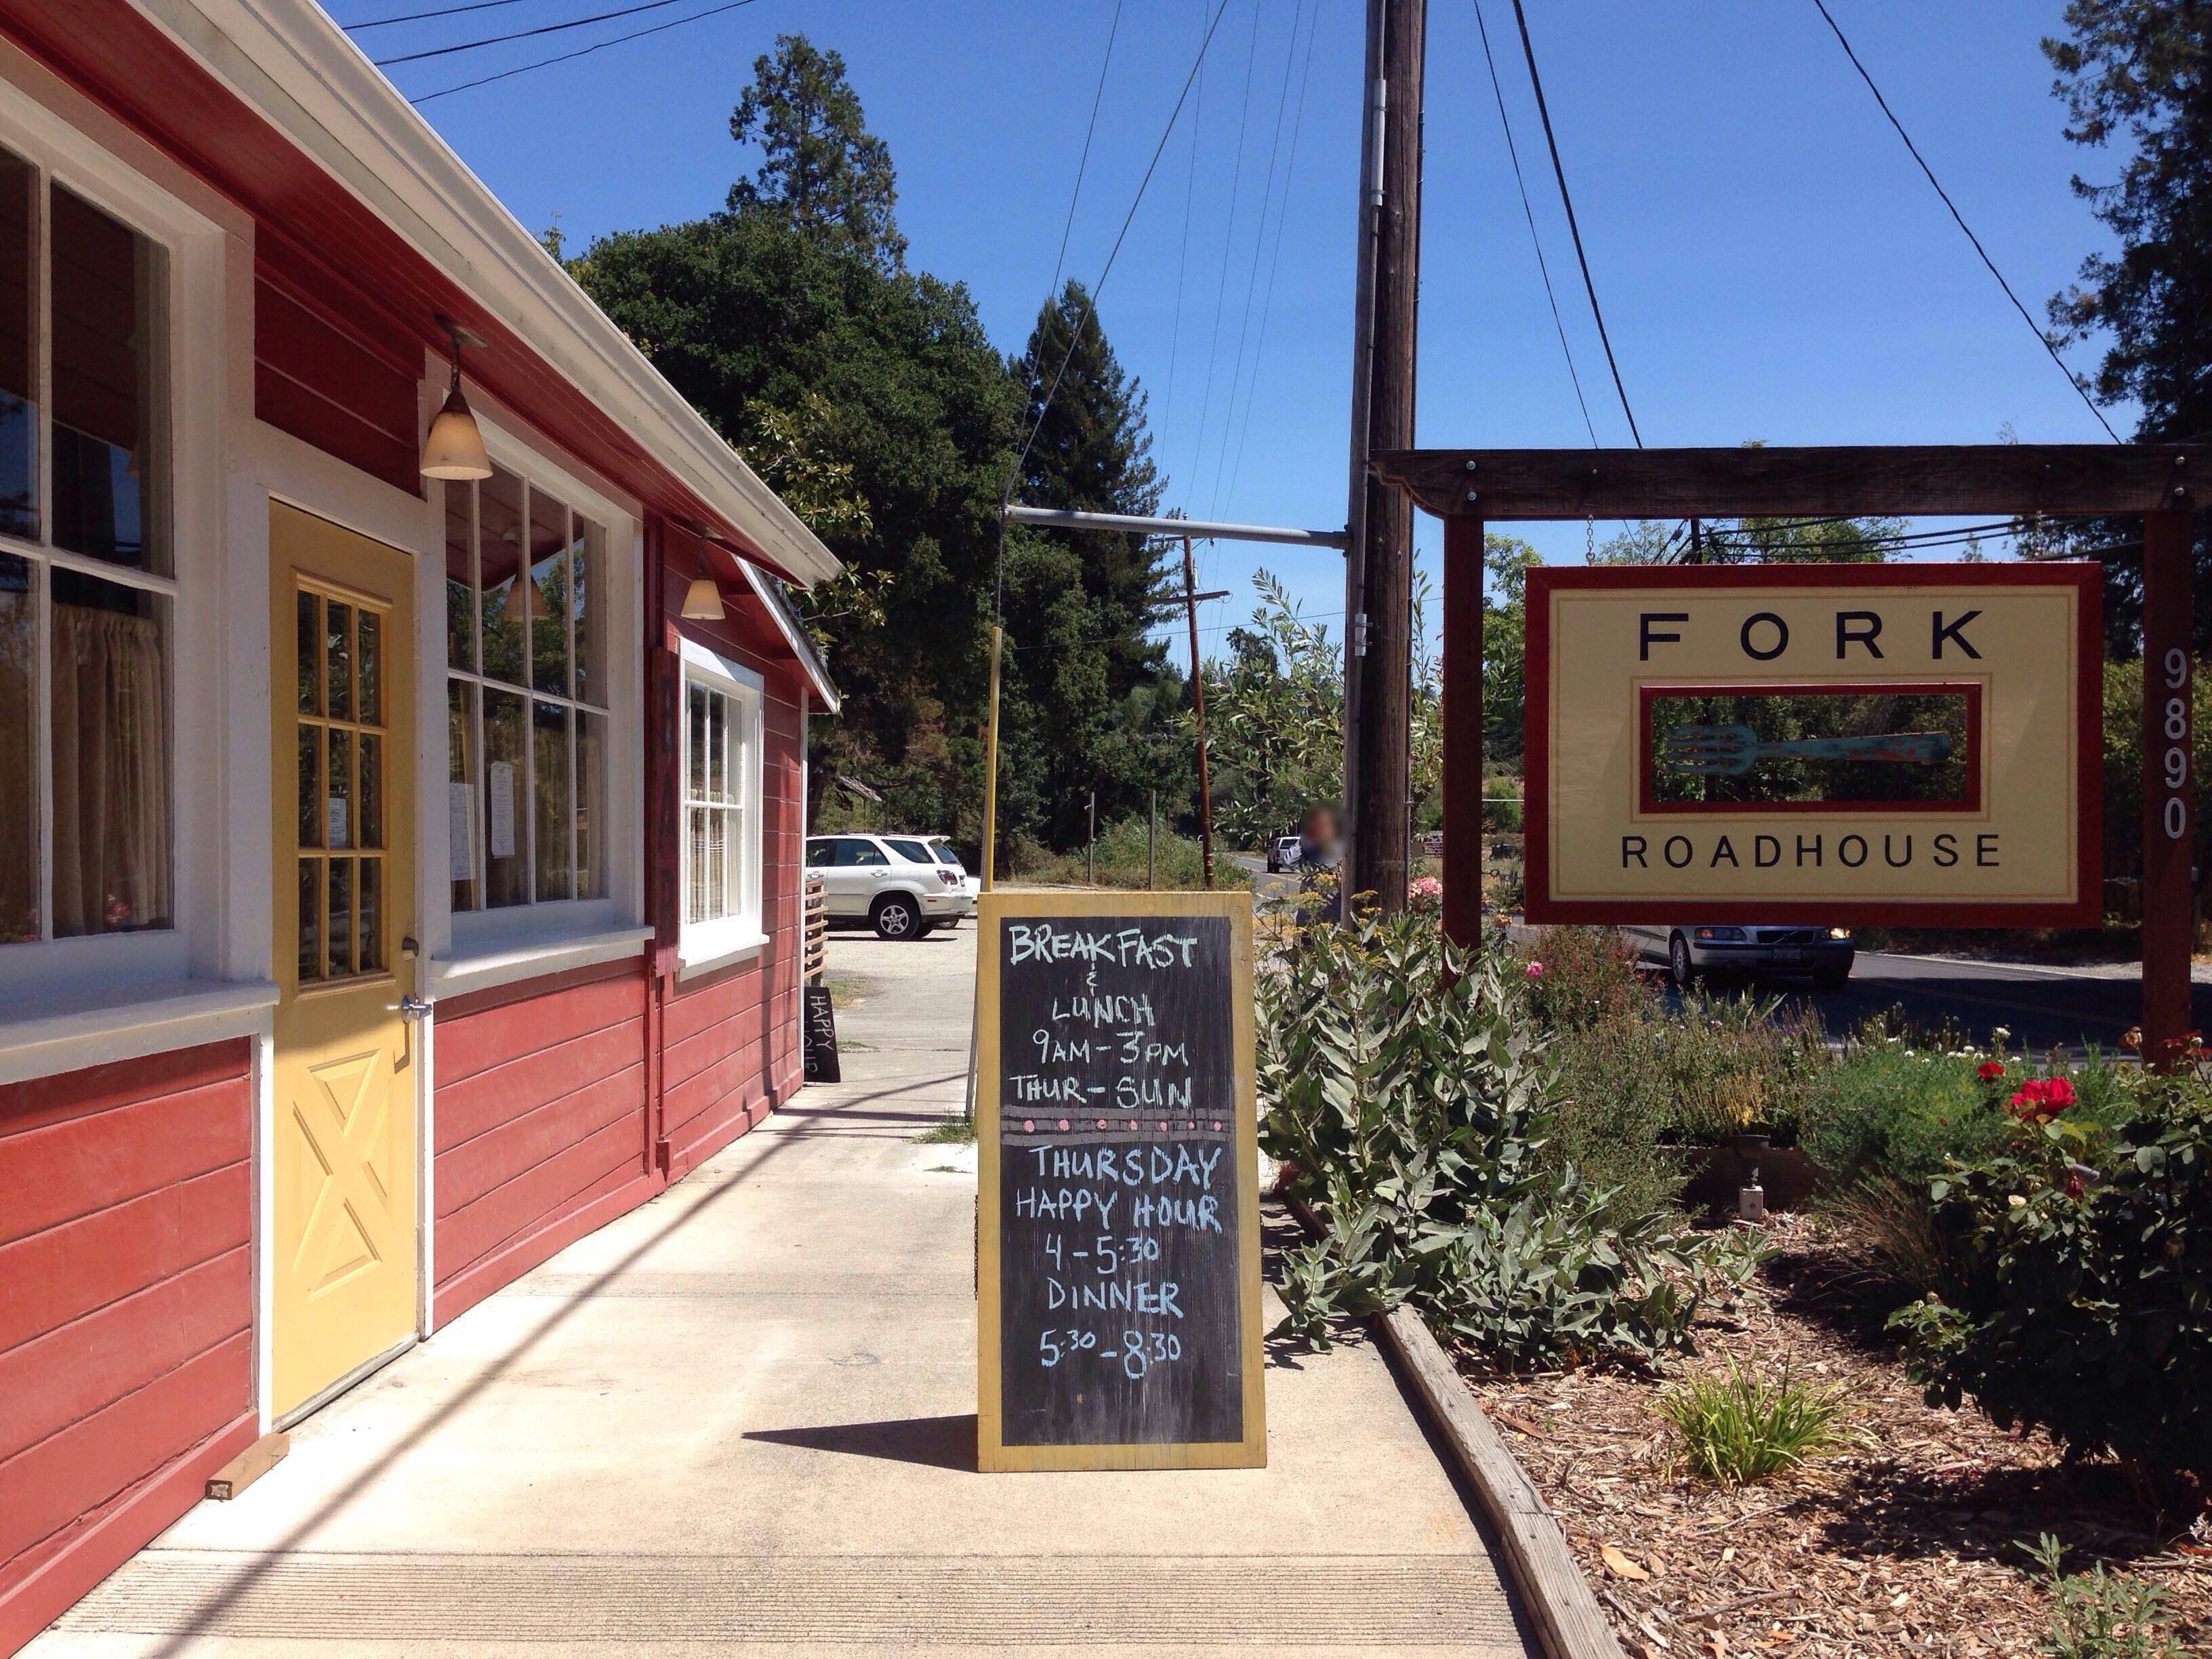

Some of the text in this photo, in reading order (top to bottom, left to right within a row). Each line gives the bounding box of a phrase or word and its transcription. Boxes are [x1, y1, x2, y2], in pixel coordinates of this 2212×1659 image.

[1638, 610, 1984, 661] FORK
[2165, 648, 2188, 839] 9890
[1622, 834, 2001, 869] ROADHOUSE
[1008, 924, 1197, 969] BREAKFAST
[810, 996, 834, 1050] HAPPY
[1052, 994, 1155, 1028] LUNCH
[1028, 1144, 1222, 1190] THURSDAY
[1015, 1186, 1223, 1234] HAPPY HOUR
[1046, 1277, 1184, 1318] DINNER
